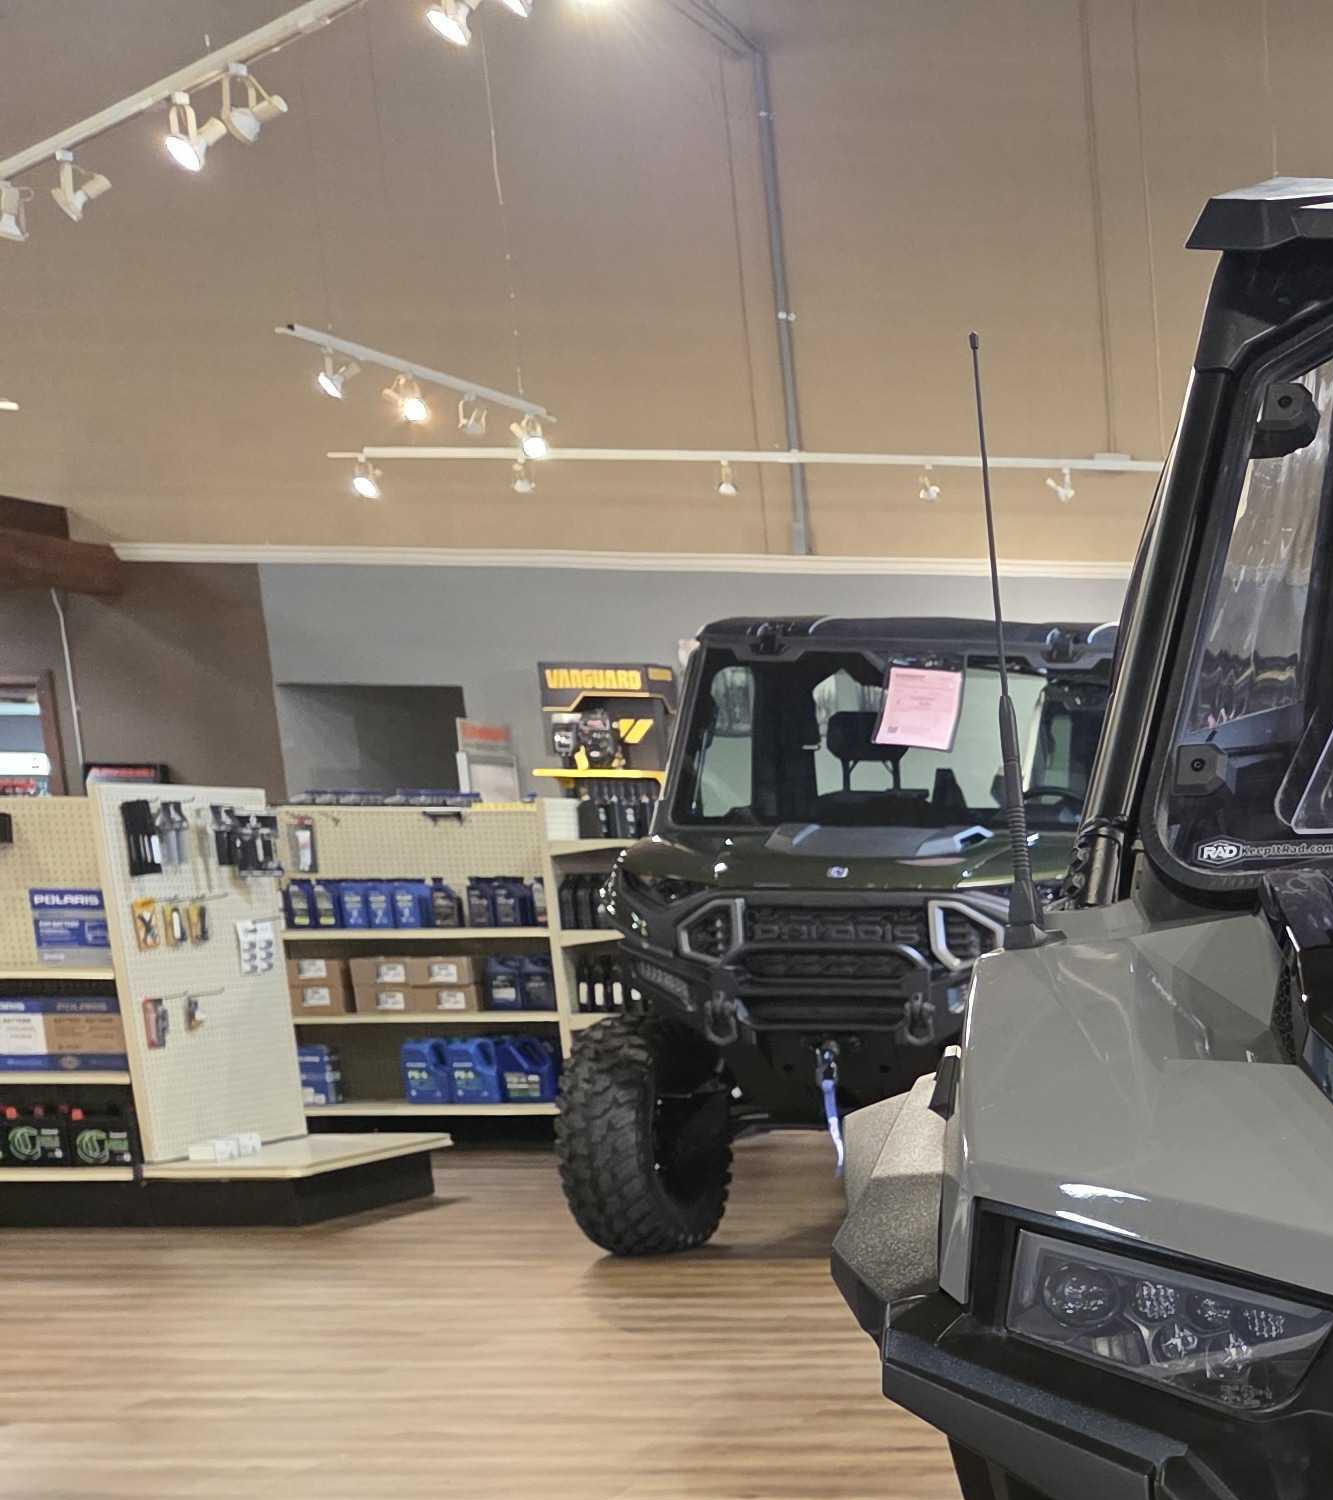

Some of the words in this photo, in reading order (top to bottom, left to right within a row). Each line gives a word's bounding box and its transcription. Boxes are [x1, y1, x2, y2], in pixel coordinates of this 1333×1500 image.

[545, 668, 642, 689] VANGUARD
[1204, 846, 1237, 859] RAD
[33, 894, 100, 906] POLARIS
